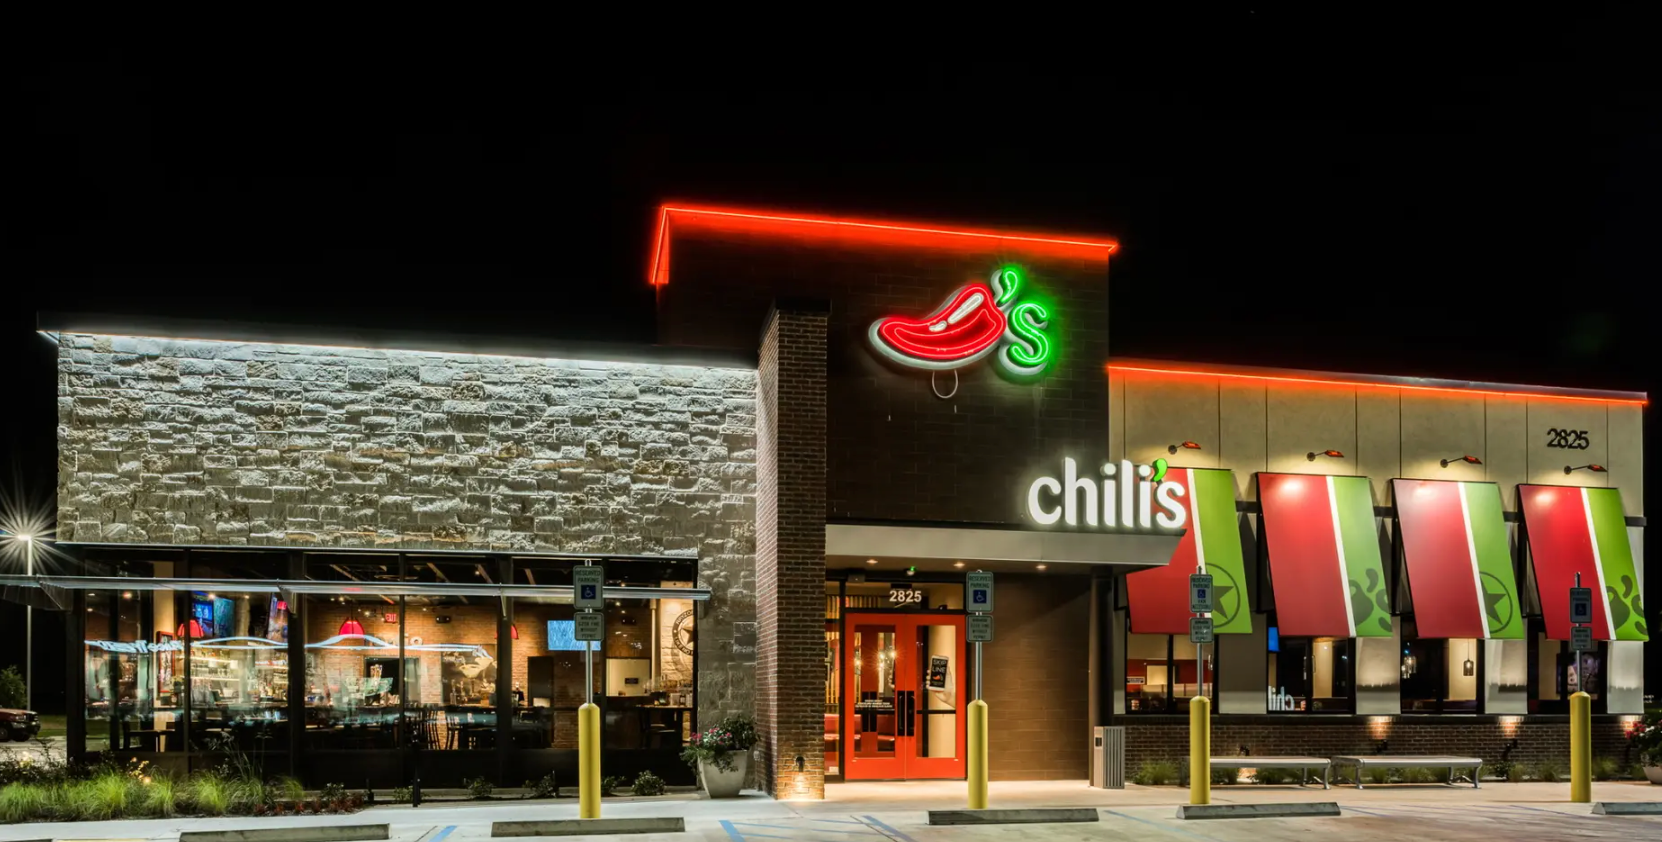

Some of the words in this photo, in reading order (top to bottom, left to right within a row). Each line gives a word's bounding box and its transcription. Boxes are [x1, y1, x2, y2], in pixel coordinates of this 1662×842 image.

[1546, 428, 1590, 451] 2825
[1027, 456, 1187, 529] chili's
[889, 590, 922, 602] 2825
[932, 666, 946, 674] LINE
